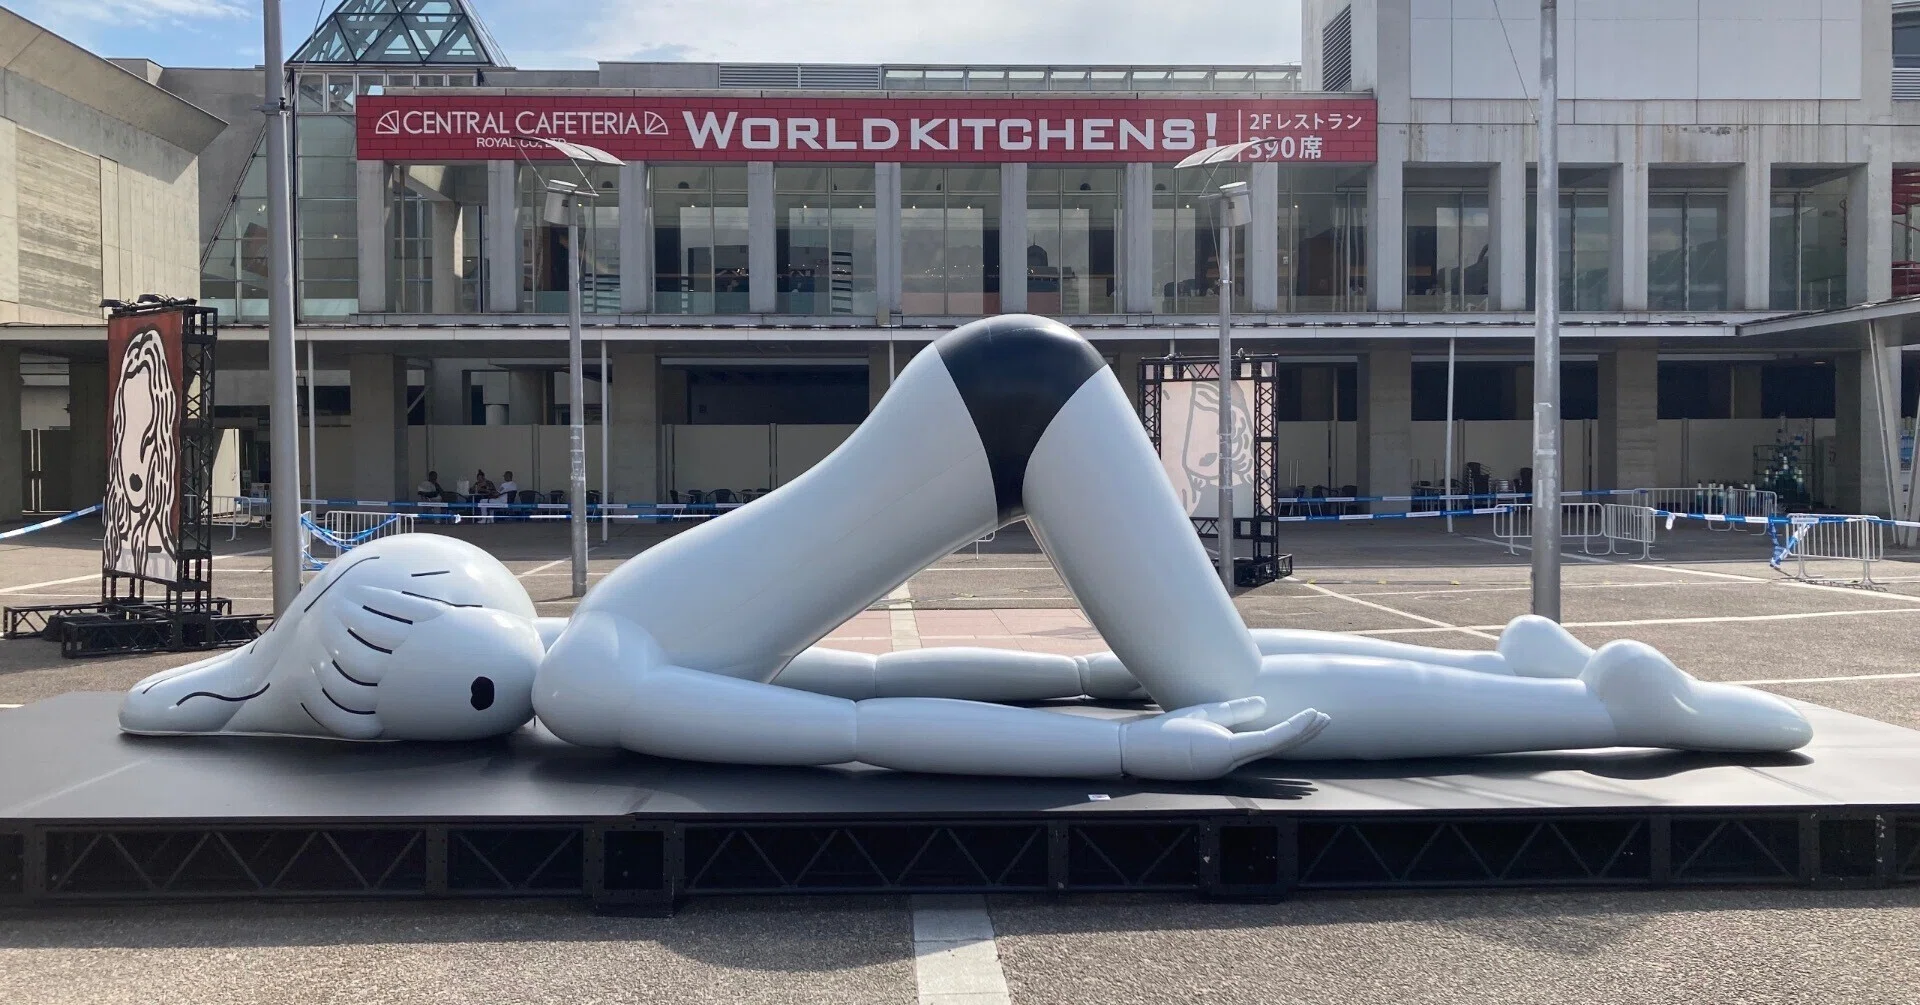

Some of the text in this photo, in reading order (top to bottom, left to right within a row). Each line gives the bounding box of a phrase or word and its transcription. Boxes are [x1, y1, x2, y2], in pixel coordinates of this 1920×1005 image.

[403, 110, 642, 135] CENTRAL CAFETERIA
[682, 111, 1218, 150] WORLD KITCHENS!
[1249, 112, 1362, 130] 2Fレストラン
[476, 137, 515, 148] ROYAL
[1248, 134, 1323, 159] 390席
